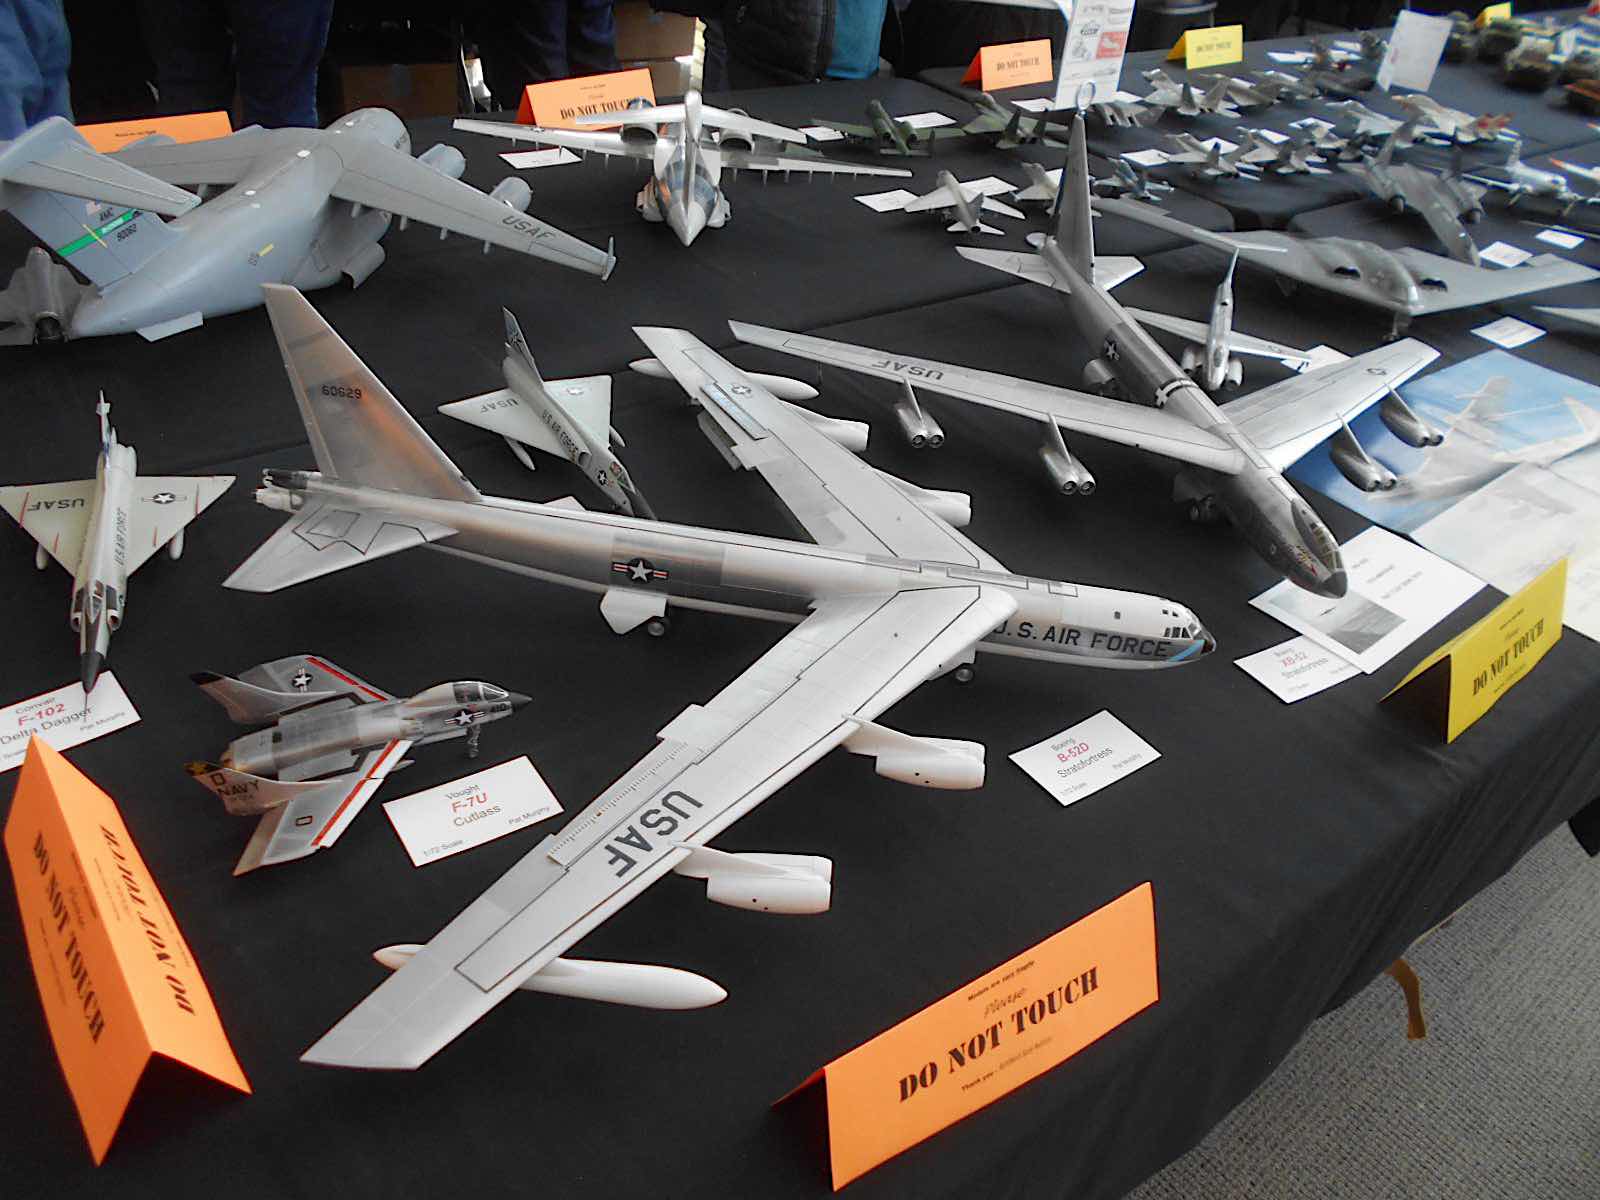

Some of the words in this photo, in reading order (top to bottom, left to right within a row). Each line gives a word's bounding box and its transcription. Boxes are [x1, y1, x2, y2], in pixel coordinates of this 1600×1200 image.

[560, 108, 576, 119] DO
[577, 103, 598, 116] NOT
[502, 215, 554, 239] USAF
[872, 360, 944, 380] USAF
[321, 385, 362, 400] 60629
[480, 397, 520, 413] USAF
[27, 498, 85, 512] USAF
[1042, 625, 1082, 647] AIR
[1090, 632, 1172, 657] FORCE
[1473, 669, 1488, 697] DO
[1490, 647, 1511, 681] NOT
[1513, 616, 1544, 660] TOUCH
[15, 697, 56, 714] Convair
[18, 703, 65, 727] F-102
[0, 727, 38, 745] Delta
[40, 707, 92, 731] Dagger
[1056, 741, 1090, 763] B-52D
[1057, 746, 1113, 778] Stratofortress
[217, 779, 259, 796] NAVY
[445, 784, 480, 800] Vought
[451, 792, 488, 813] F-7U
[453, 805, 502, 827] Cutlass
[604, 790, 704, 878] USAF
[34, 831, 50, 876] DO
[48, 871, 69, 934] NOT
[65, 930, 105, 1045] TOUCH
[137, 911, 176, 970] NOT
[165, 974, 196, 1015] DO
[899, 1061, 938, 1104] DO
[947, 1020, 1003, 1075] NOT
[1011, 965, 1100, 1036] TOUCH
